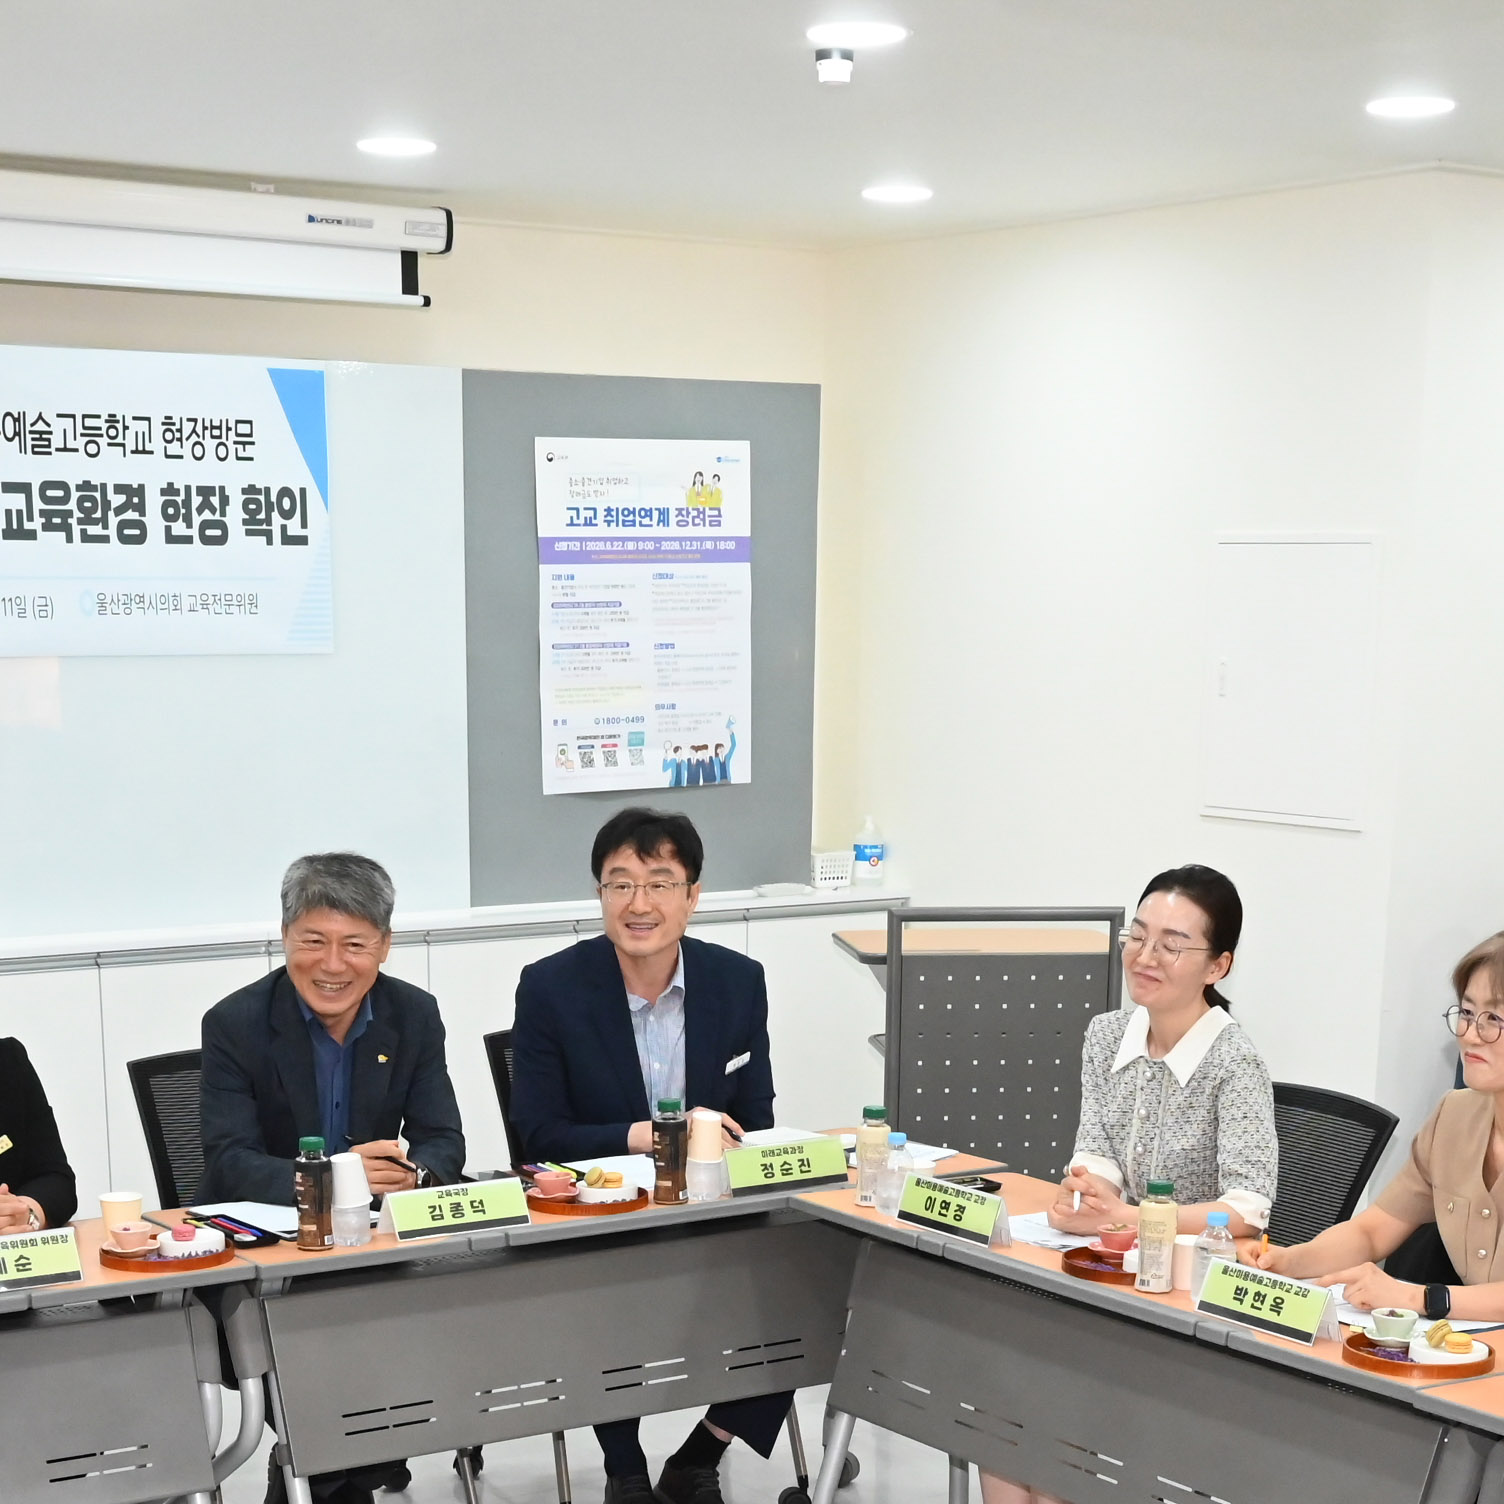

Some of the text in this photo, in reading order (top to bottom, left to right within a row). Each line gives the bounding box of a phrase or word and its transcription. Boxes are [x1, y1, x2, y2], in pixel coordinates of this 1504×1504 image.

[161, 415, 257, 463] 현장방문
[0, 479, 149, 546] 교육환경
[159, 481, 231, 547] 현장
[240, 483, 310, 548] 확인
[565, 505, 724, 528] 고교 취업연계 장려금
[0, 594, 28, 618] 11일
[31, 594, 56, 620] (금)
[95, 592, 260, 617] 울산광역시의회 교육전문위원
[601, 715, 646, 726] 1800-0499
[760, 1146, 804, 1159] 미래교육과장
[435, 1187, 469, 1199] 교육국장
[40, 1233, 69, 1246] 위원장
[1221, 1264, 1311, 1299] 울산미용예술고등학교 교감
